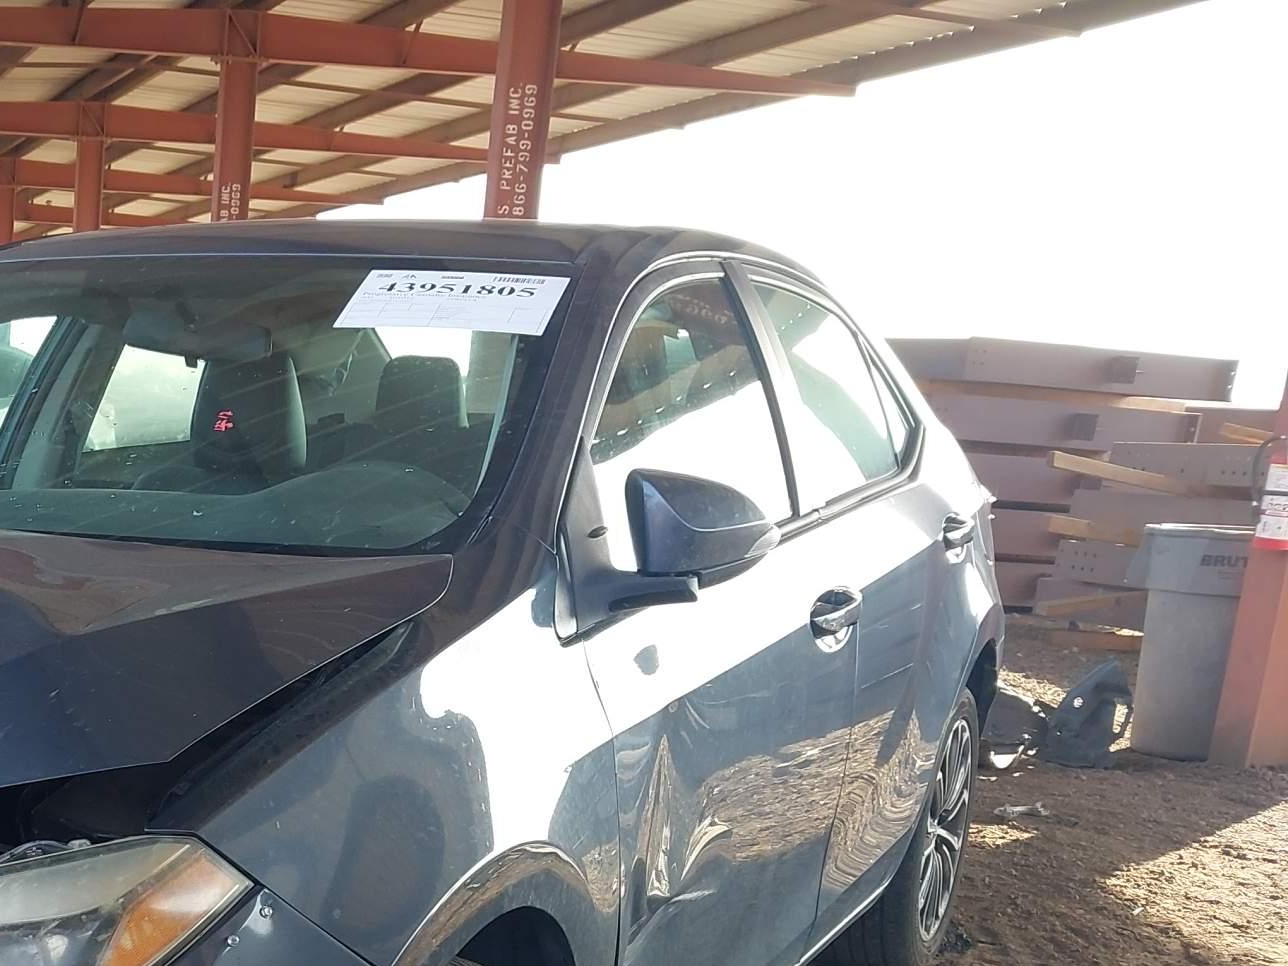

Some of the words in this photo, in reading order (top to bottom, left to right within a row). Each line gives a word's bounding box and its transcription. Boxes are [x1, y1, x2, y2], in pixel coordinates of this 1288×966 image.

[508, 82, 523, 115] INC.
[499, 124, 519, 191] PREFAB
[512, 84, 538, 216] 866-799-0969
[378, 281, 537, 298] 43951805
[1199, 553, 1249, 569] BRUT
